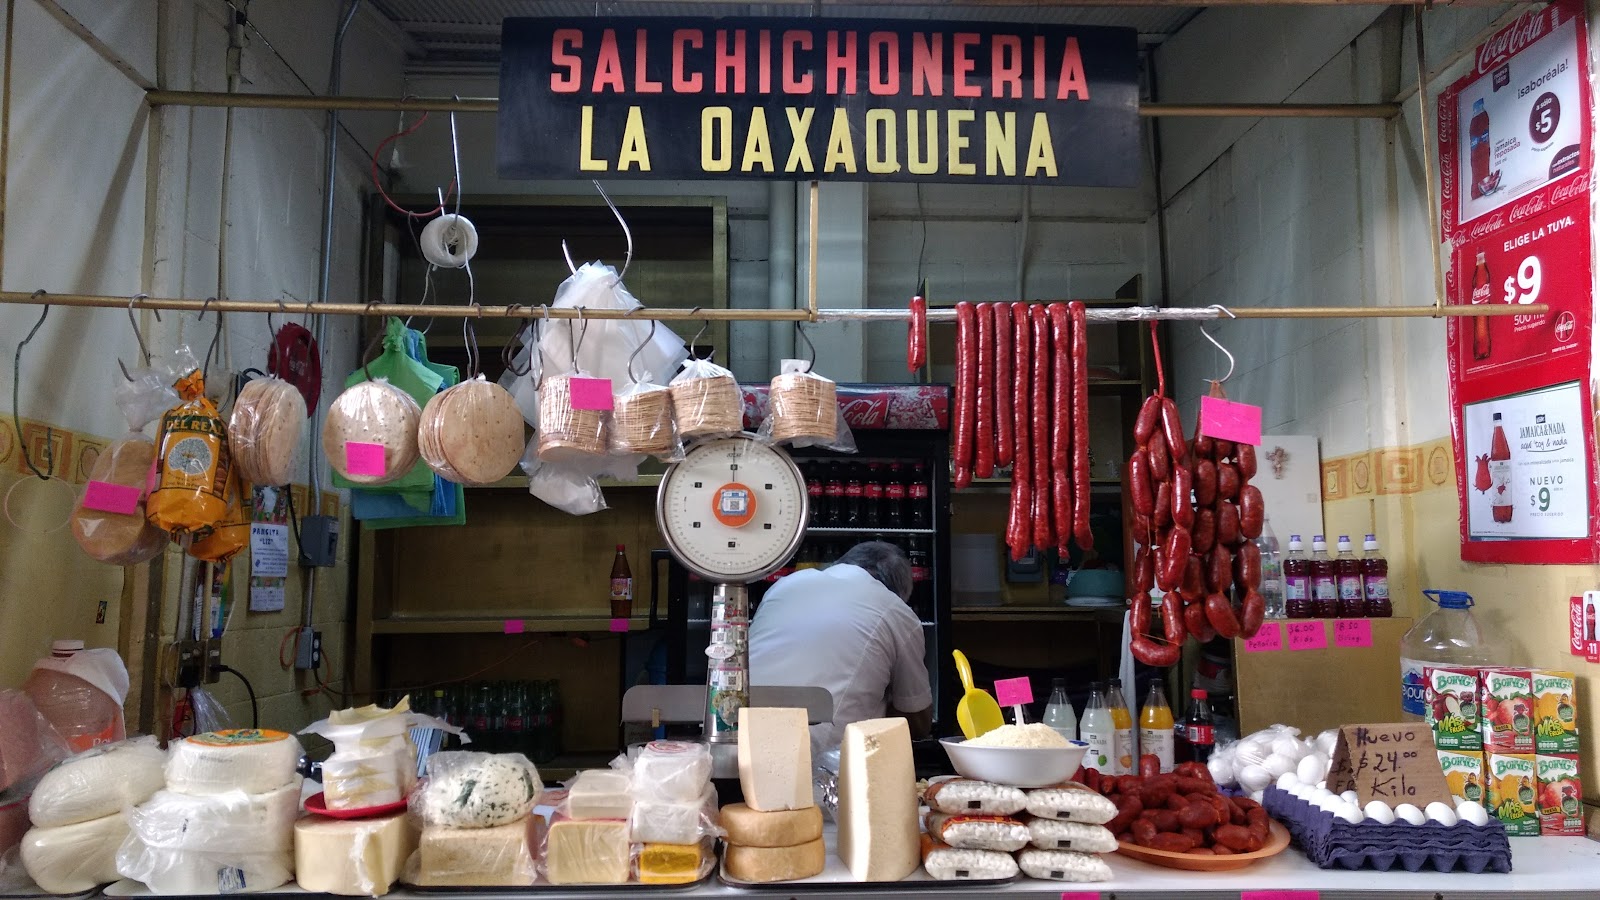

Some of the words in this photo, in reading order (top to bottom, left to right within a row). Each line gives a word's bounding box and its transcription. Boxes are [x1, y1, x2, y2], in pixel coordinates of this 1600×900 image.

[550, 28, 1090, 100] SALCHICHONERIA
[1517, 58, 1569, 100] ¡saboréala!
[1535, 108, 1552, 134] $5
[580, 105, 651, 172] LA
[701, 106, 1059, 177] OAXAQUENA
[1494, 141, 1521, 160] reposada
[1503, 232, 1530, 253] ELIGE
[1532, 228, 1545, 242] LA
[1546, 215, 1575, 235] TUYA.
[1503, 255, 1542, 305] $9
[166, 420, 188, 430] DEL
[1529, 475, 1564, 486] NUEVO
[1529, 486, 1551, 512] $9
[1356, 727, 1415, 748] Huevo
[1371, 774, 1416, 797] Kilo
